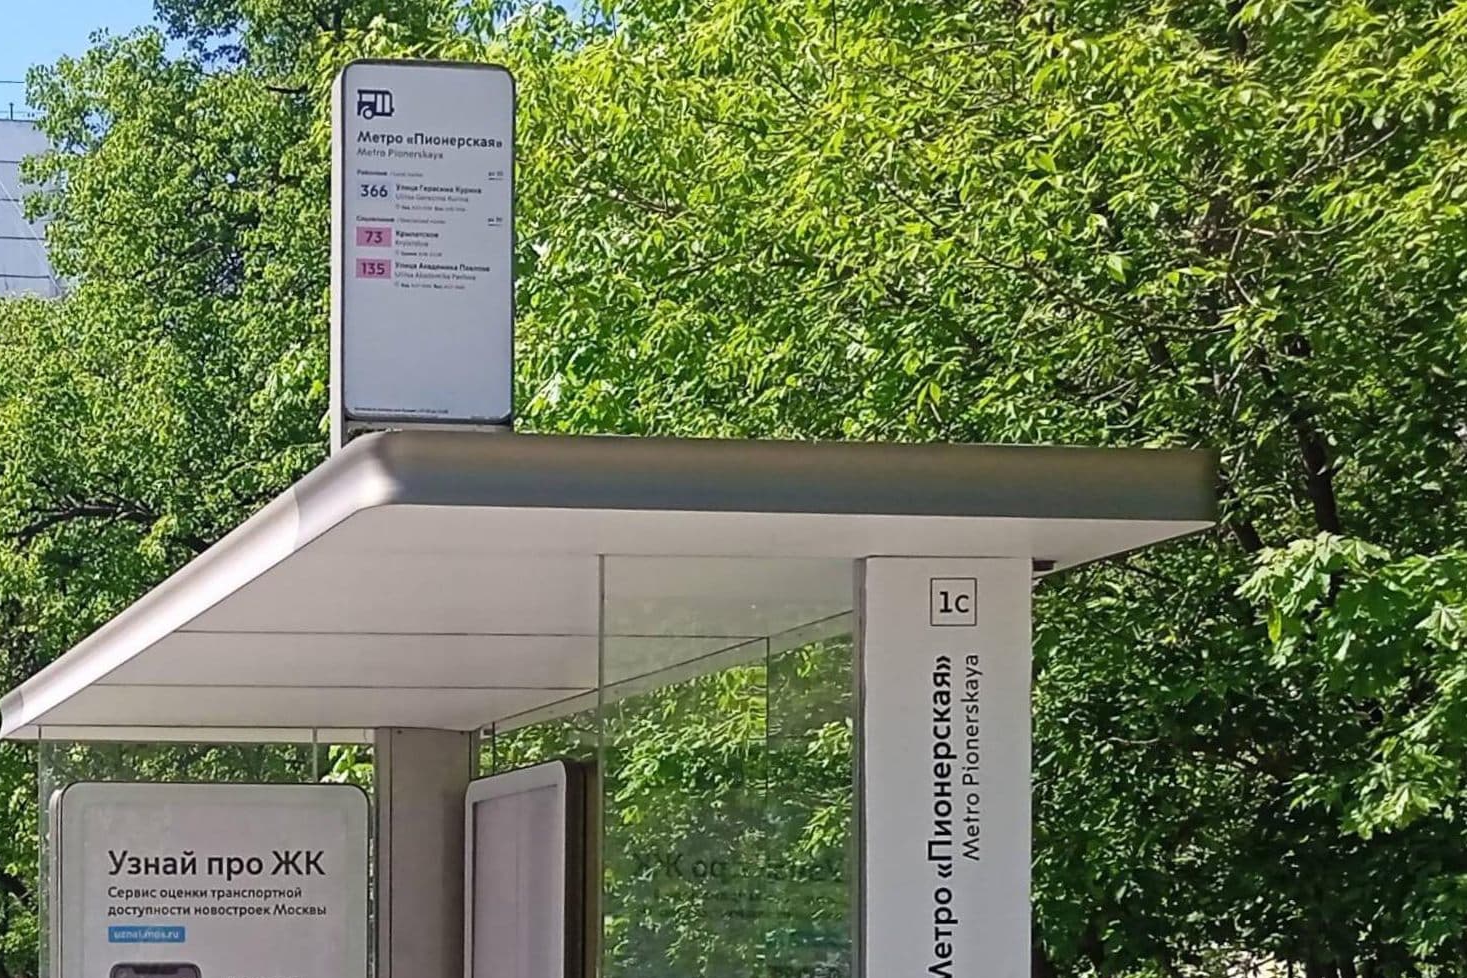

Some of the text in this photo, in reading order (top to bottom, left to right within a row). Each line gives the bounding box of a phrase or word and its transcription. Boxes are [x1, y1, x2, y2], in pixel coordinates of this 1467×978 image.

[356, 131, 503, 149] Метро «Пионерская»
[360, 184, 388, 198] 366
[364, 230, 383, 244] 73
[362, 262, 385, 275] 135
[961, 653, 984, 861] Metro Pionerskaya
[927, 654, 958, 880] «Пионерская»
[108, 850, 326, 881] Узнай про ЖК
[107, 886, 302, 900] Сервис оценки транспортной
[108, 904, 327, 918] доступности новостроек Москвы
